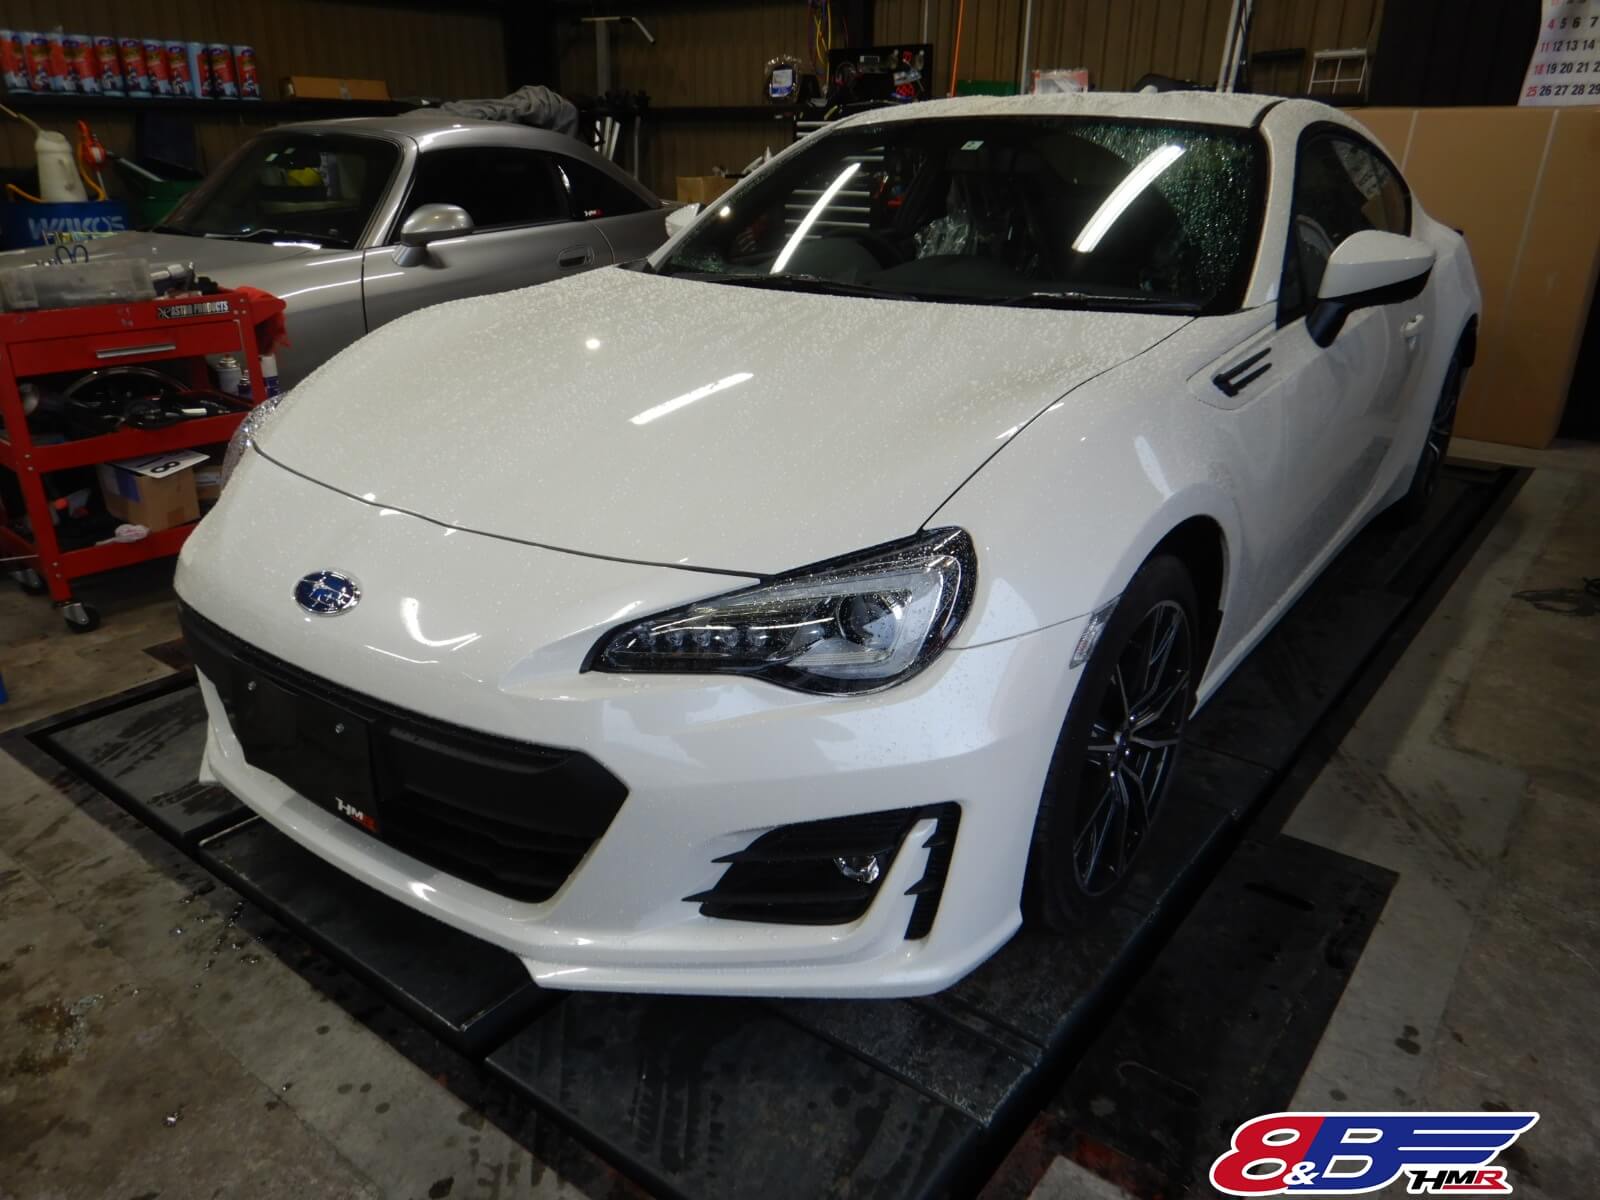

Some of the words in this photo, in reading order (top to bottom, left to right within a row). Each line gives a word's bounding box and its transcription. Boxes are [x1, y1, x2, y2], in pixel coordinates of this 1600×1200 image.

[1548, 18, 1555, 29] 4
[1560, 17, 1567, 29] 5
[1572, 17, 1581, 28] 6
[1590, 17, 1598, 27] 7
[1541, 42, 1549, 52] 11
[1553, 41, 1562, 52] 12
[1566, 40, 1577, 51] 13
[1583, 40, 1595, 50] 14
[1535, 64, 1545, 75] 18
[1546, 63, 1557, 74] 19
[1560, 63, 1573, 73] 20
[1576, 63, 1589, 73] 21
[1593, 62, 1600, 73] 2
[1526, 87, 1537, 97] 25
[1539, 86, 1552, 96] 26
[1554, 86, 1568, 96] 27
[1571, 85, 1585, 95] 28
[1588, 84, 1600, 95] 29
